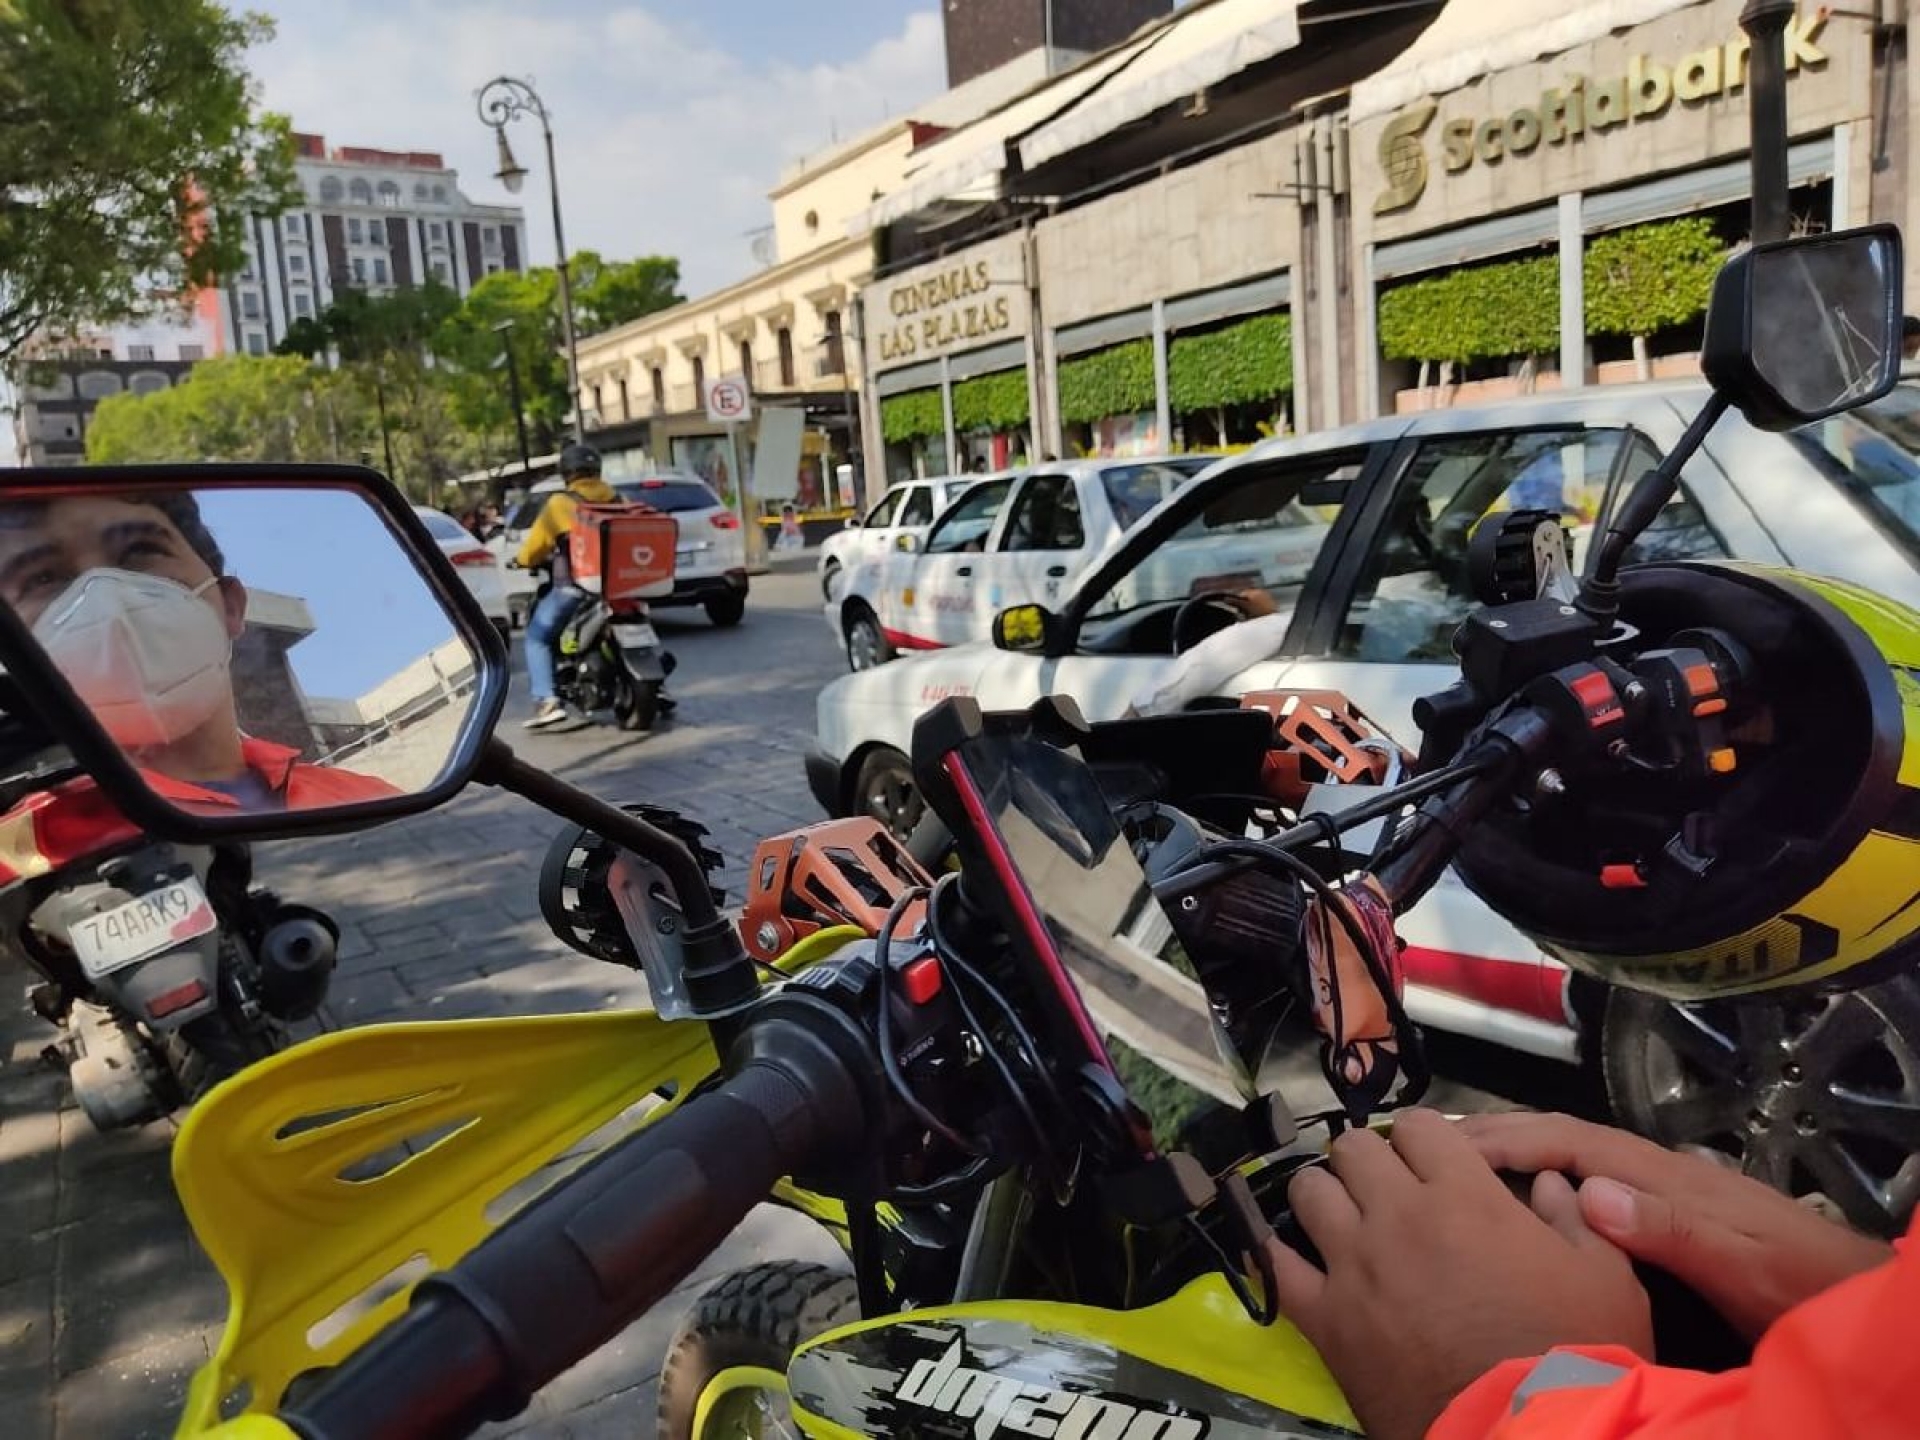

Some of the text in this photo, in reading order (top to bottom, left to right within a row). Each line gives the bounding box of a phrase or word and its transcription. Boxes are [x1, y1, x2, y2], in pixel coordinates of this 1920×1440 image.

[889, 261, 990, 317] CINEMAS
[879, 297, 1010, 360] LAS PLAZAS
[83, 888, 190, 951] 74ARK9
